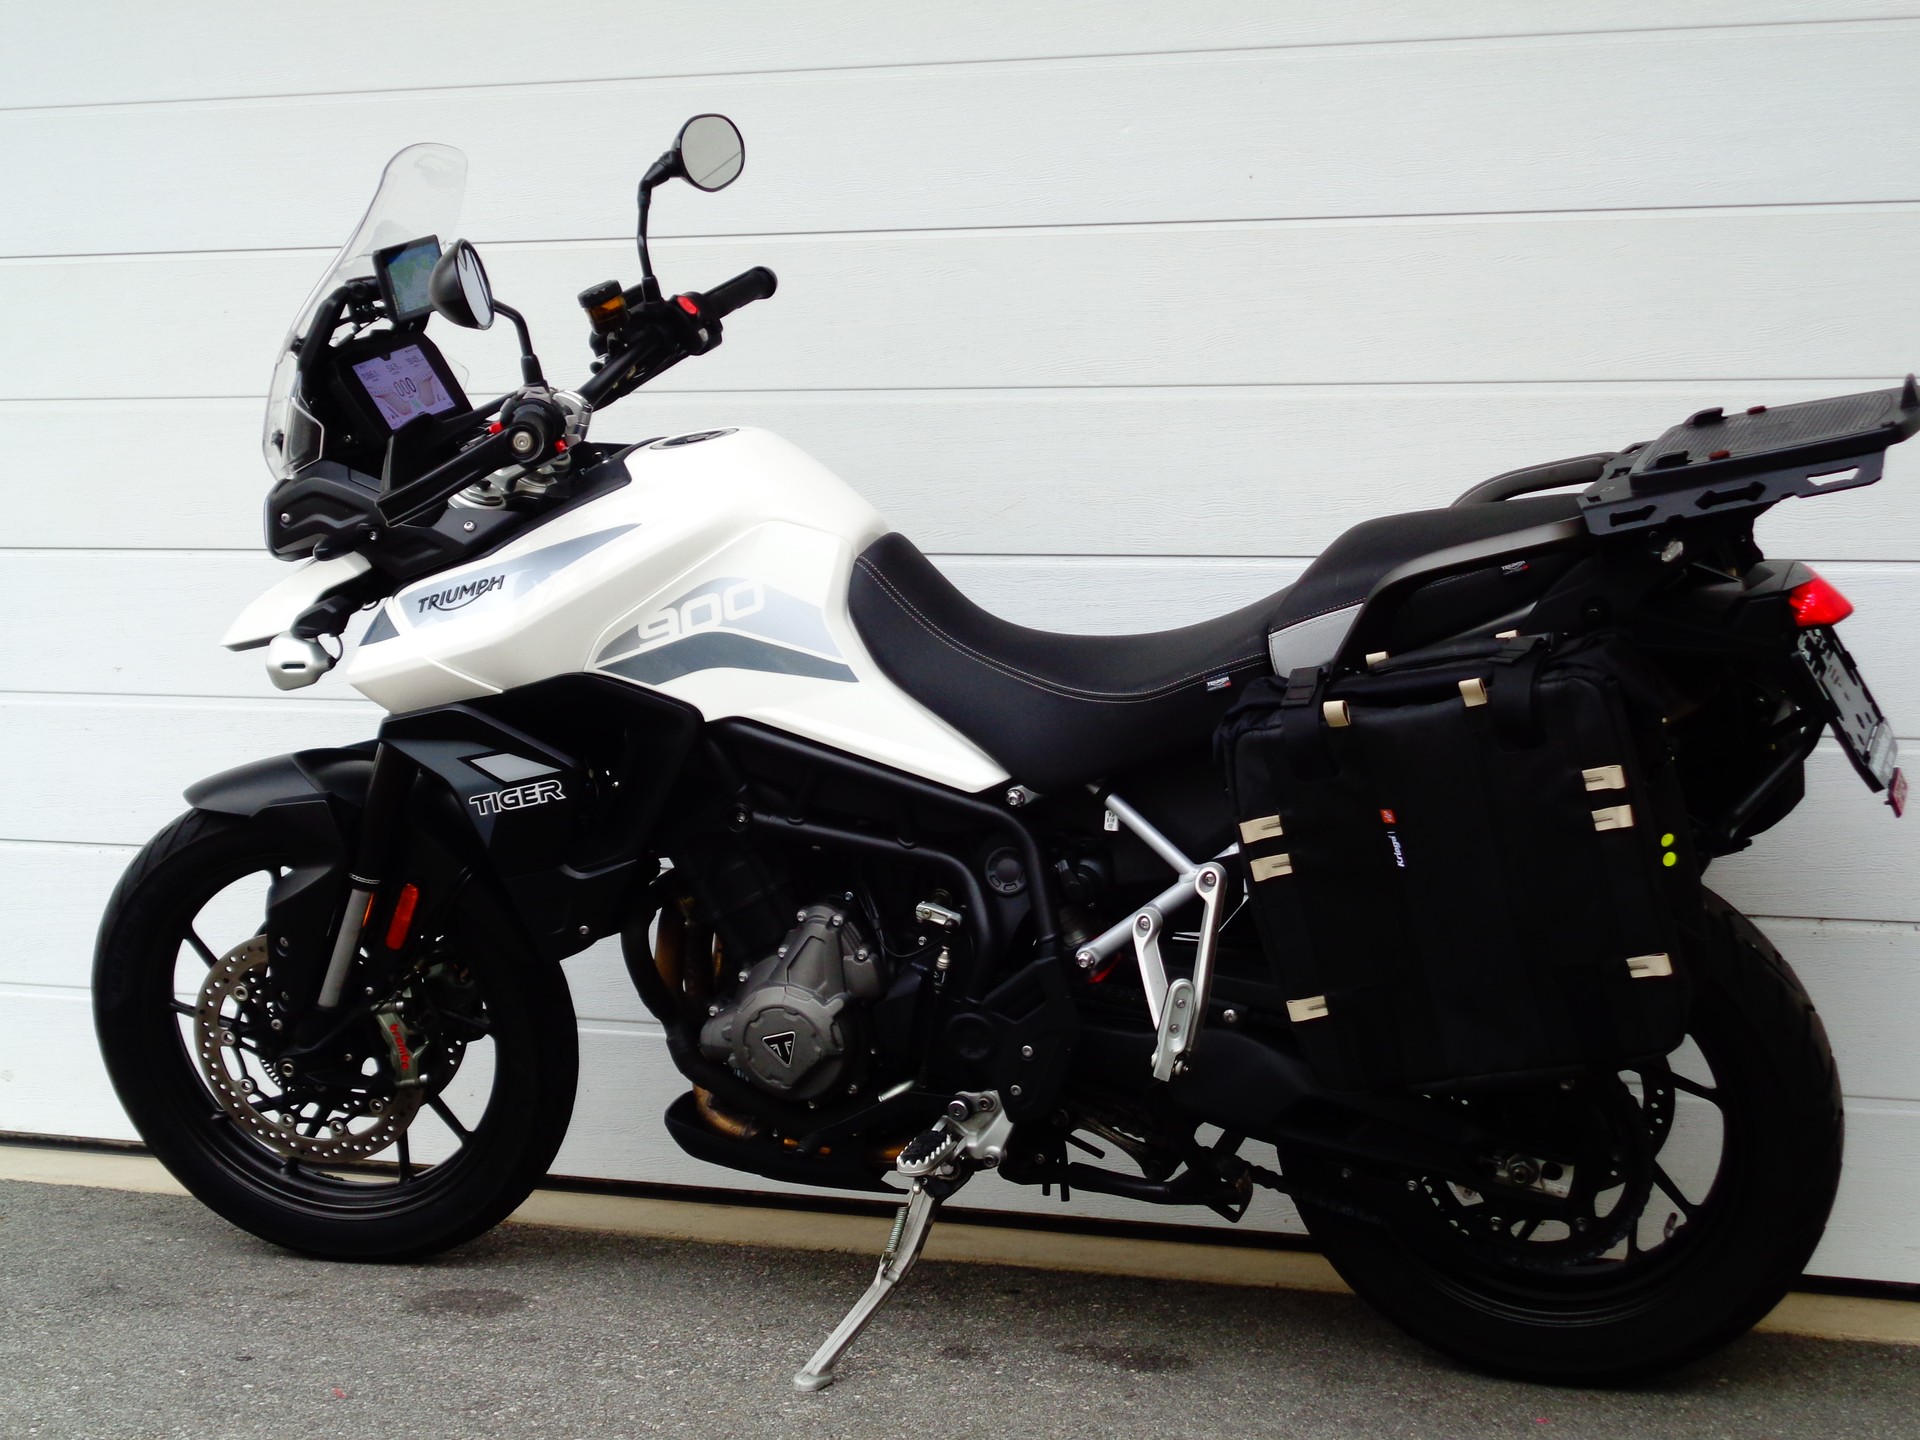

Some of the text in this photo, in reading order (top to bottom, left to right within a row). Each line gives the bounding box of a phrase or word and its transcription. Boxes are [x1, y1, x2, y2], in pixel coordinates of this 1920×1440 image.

[418, 574, 505, 613] TRIUMPH
[637, 582, 765, 644] 900
[468, 779, 567, 816] TIGER
